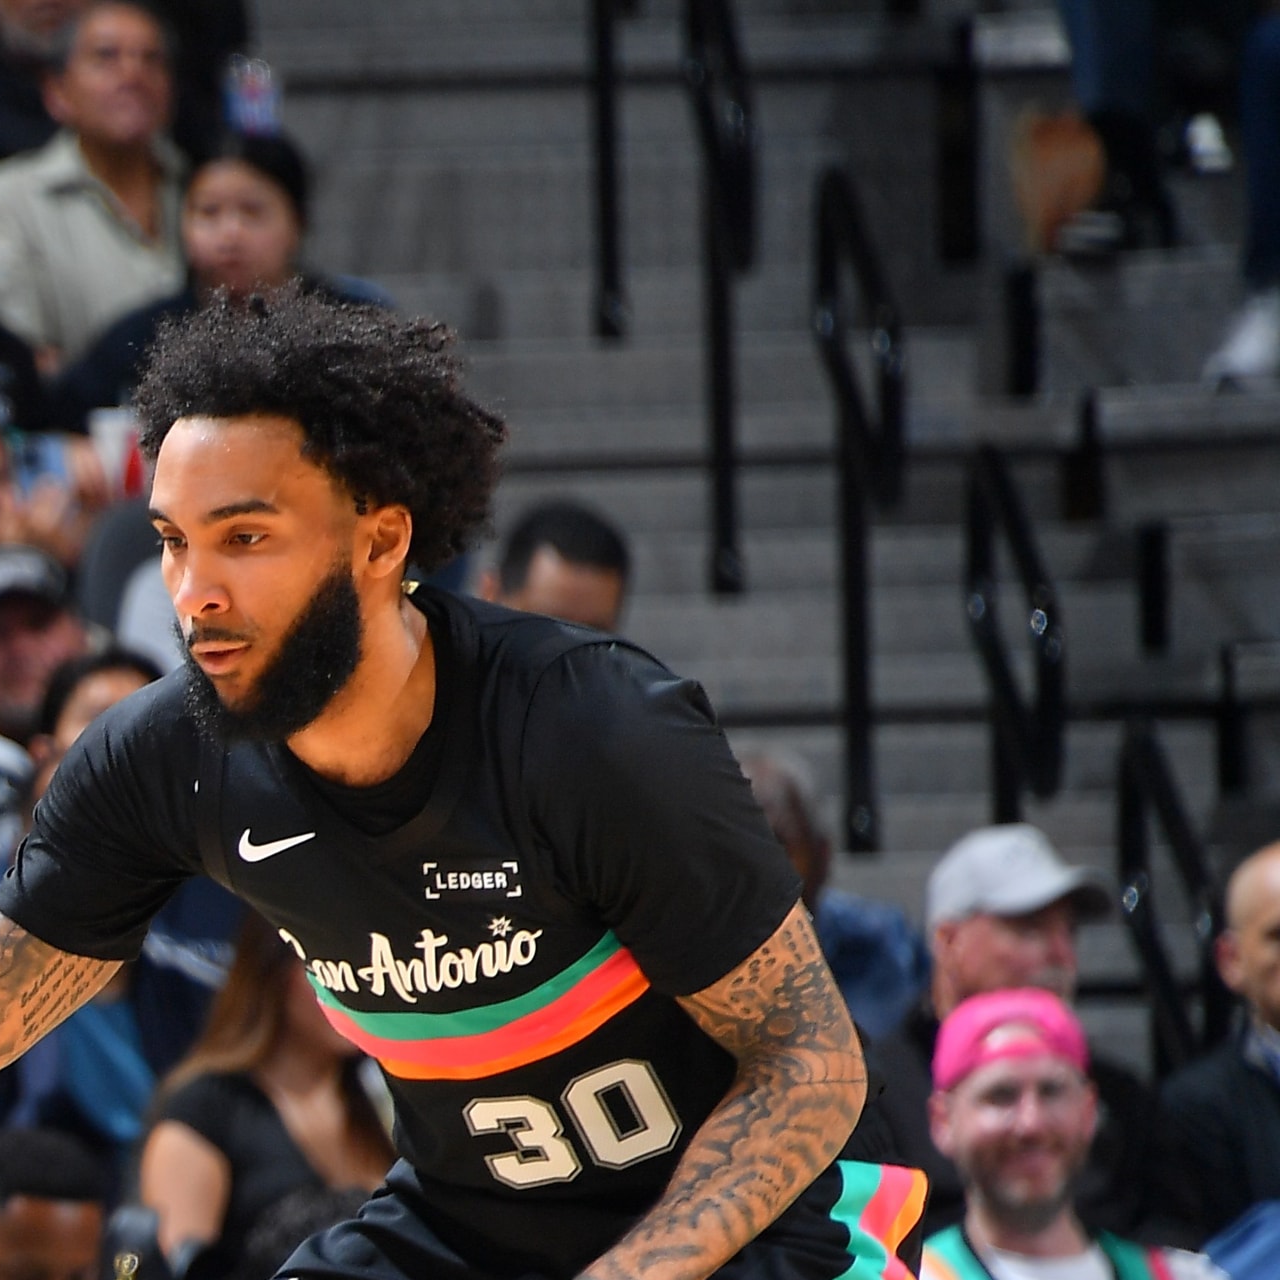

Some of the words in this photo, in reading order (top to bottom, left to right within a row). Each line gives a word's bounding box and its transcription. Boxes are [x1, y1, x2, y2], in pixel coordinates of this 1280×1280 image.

[435, 871, 508, 889] LEDGER
[278, 928, 360, 993] an
[357, 926, 543, 1003] Antonio
[462, 1058, 683, 1190] 30
